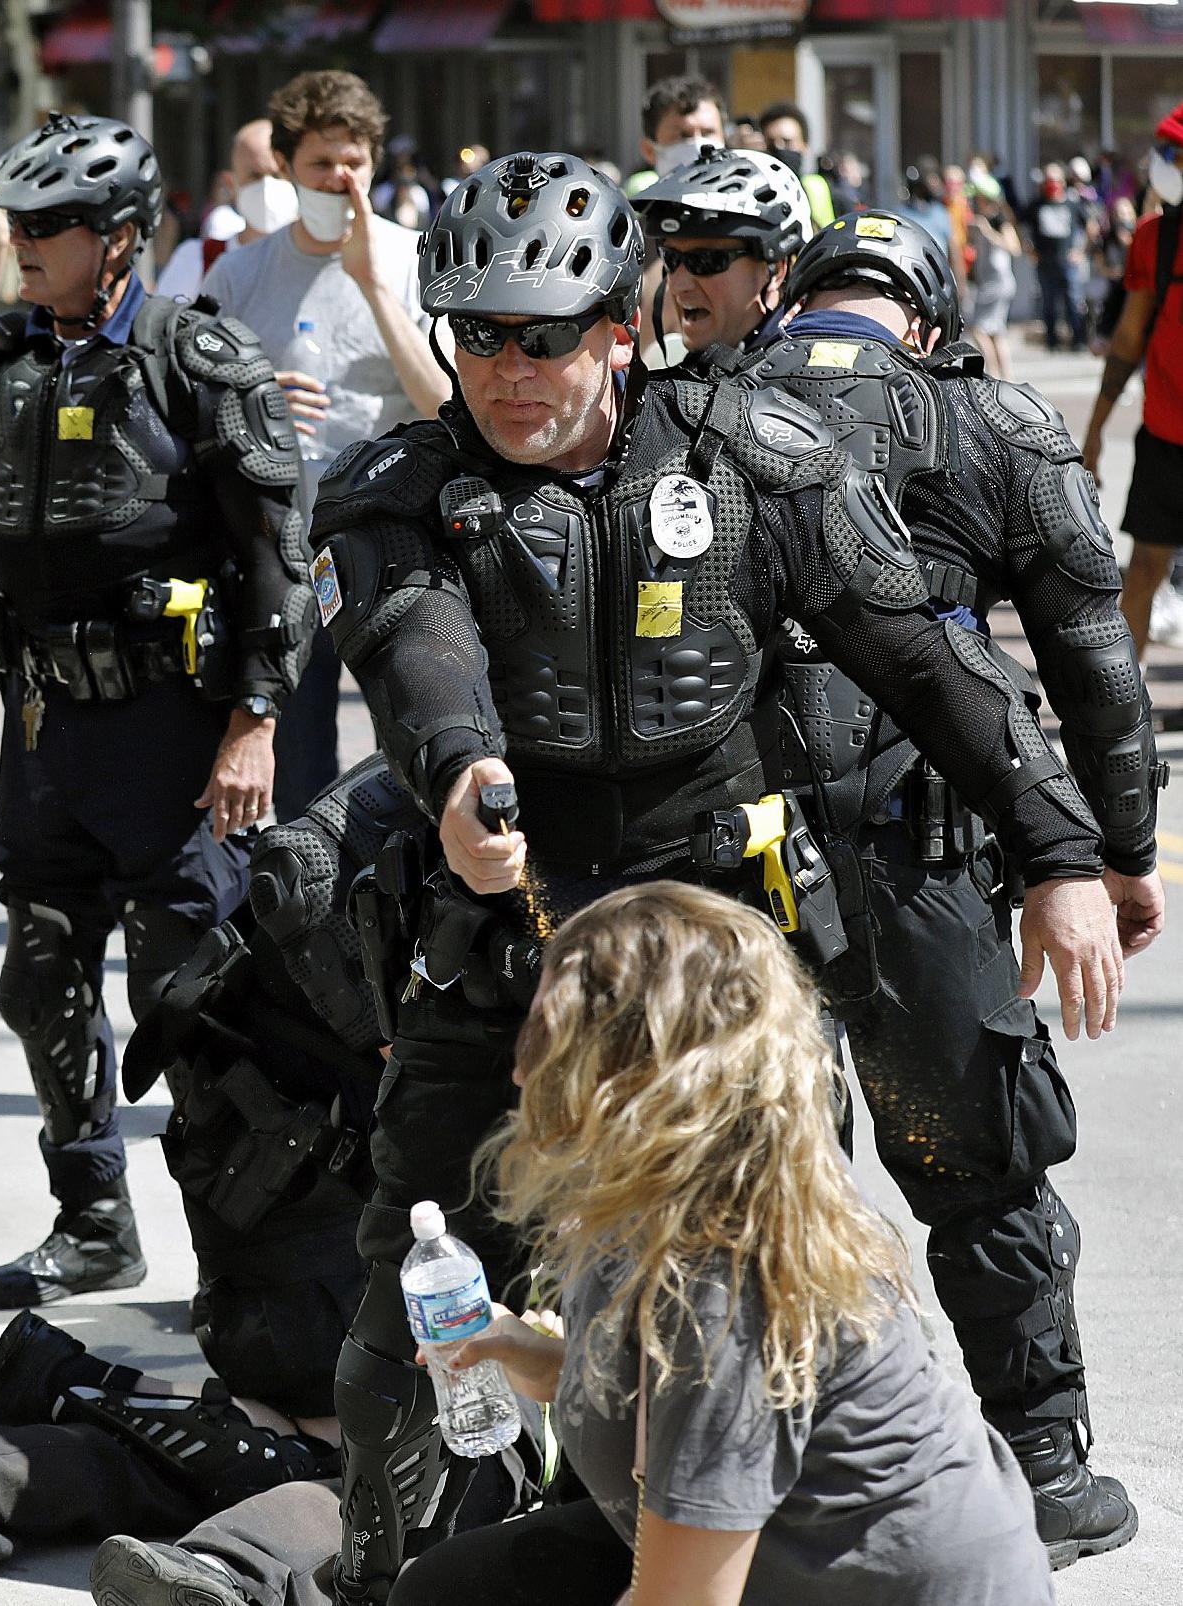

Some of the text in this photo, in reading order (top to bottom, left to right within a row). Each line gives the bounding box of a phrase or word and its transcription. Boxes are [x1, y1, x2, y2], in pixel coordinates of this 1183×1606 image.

[367, 448, 407, 481] FOX
[513, 503, 544, 522] C2
[673, 540, 697, 548] POLICE
